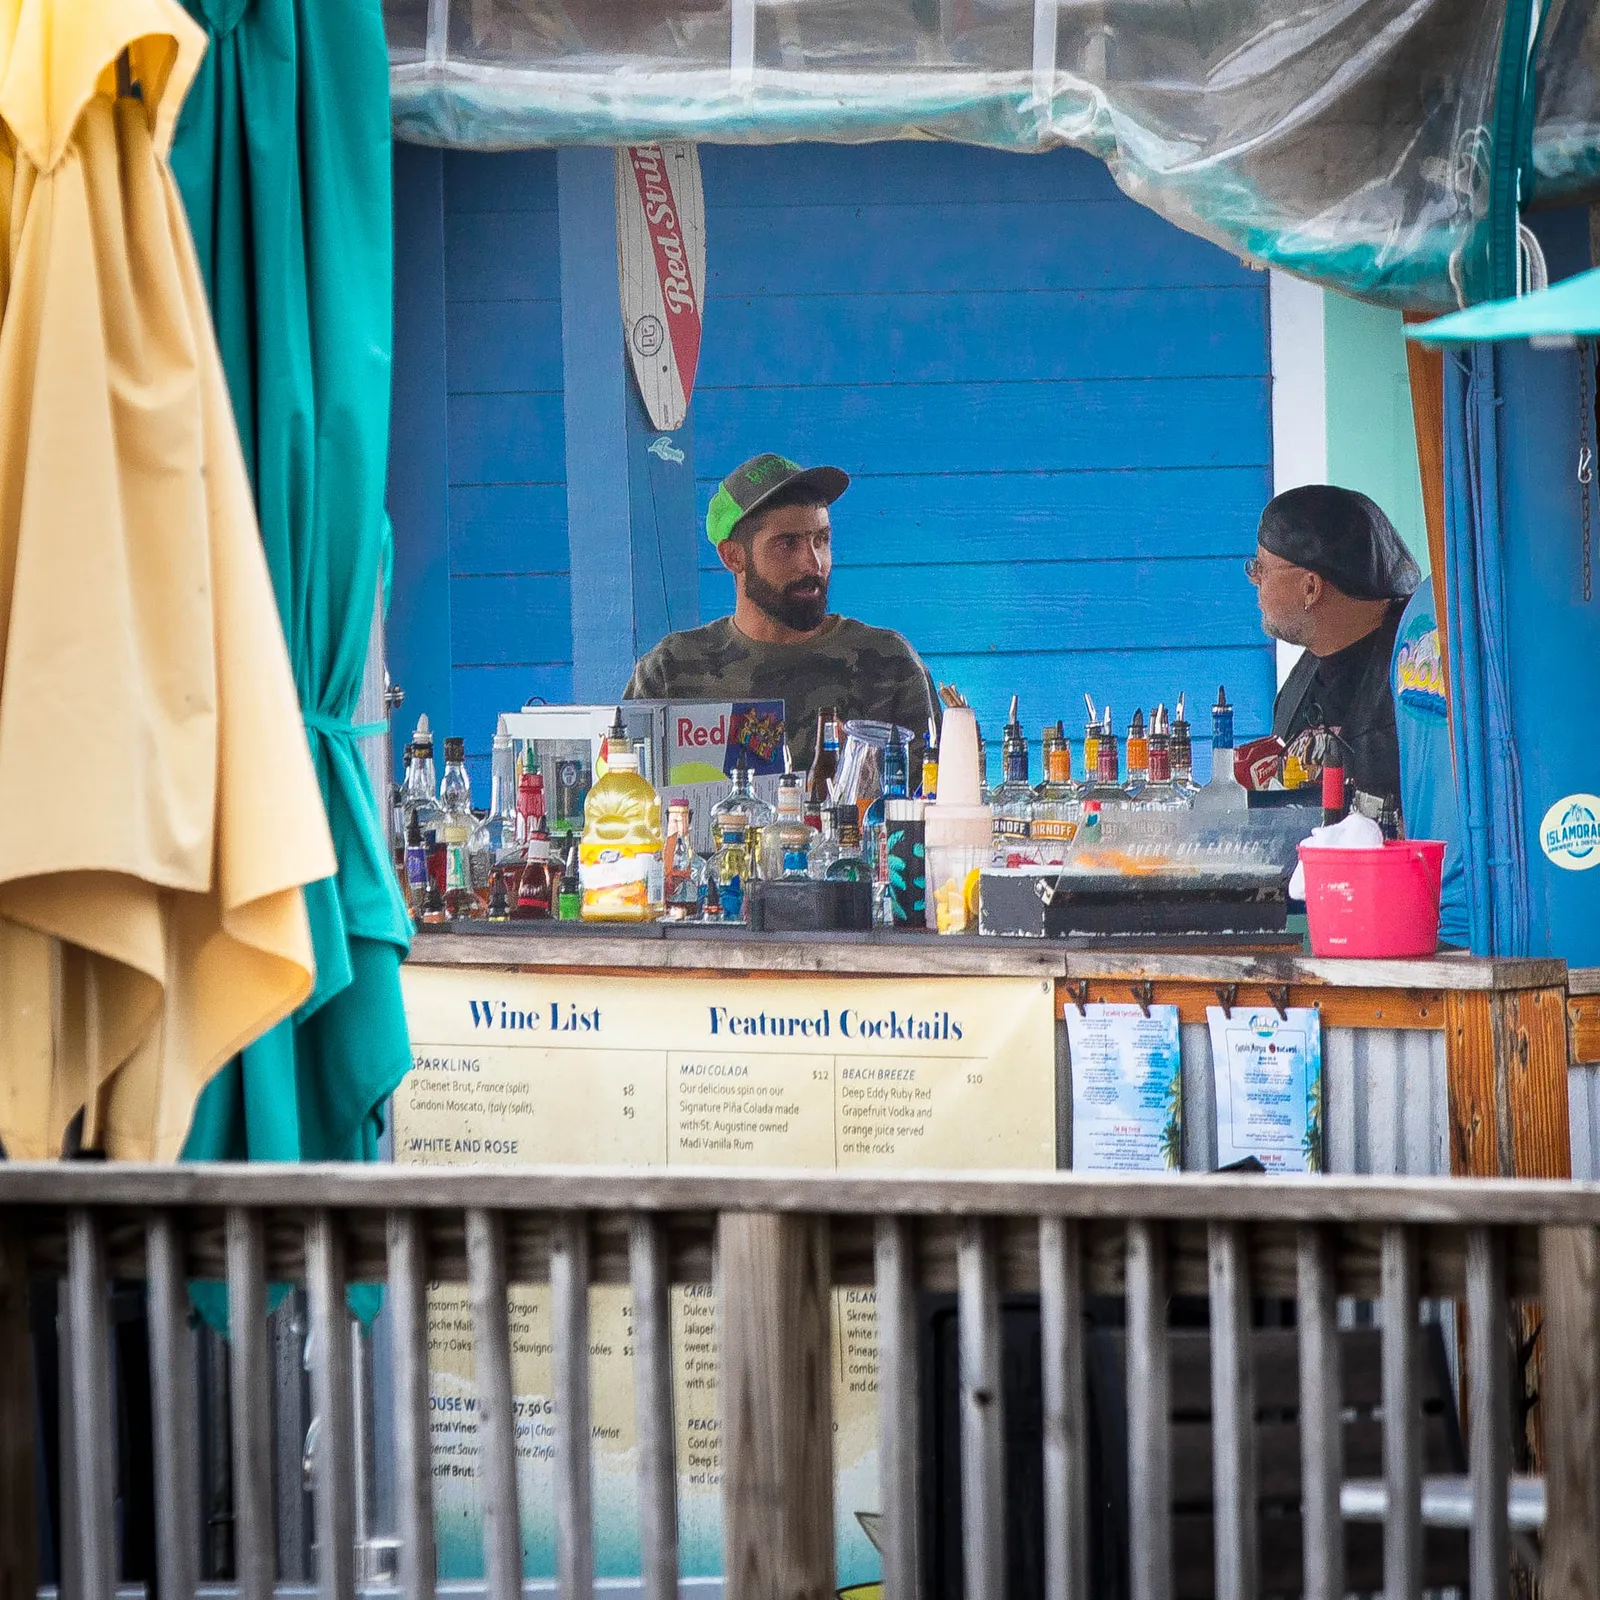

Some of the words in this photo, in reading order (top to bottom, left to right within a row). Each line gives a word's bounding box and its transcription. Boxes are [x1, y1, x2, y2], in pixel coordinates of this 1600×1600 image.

[633, 145, 675, 228] Strip
[656, 231, 694, 315] Red
[677, 714, 727, 747] Red
[991, 820, 1026, 834] IRNOFF
[1127, 843, 1171, 857] EVERY
[1176, 842, 1200, 855] BIT
[1206, 841, 1260, 856] EARNED
[469, 1000, 540, 1030] Wine
[549, 1002, 602, 1031] List
[708, 1006, 830, 1037] Featured
[839, 1008, 964, 1041] Cocktails
[680, 1064, 706, 1076] MADI
[708, 1065, 748, 1077] COLADA
[812, 1070, 829, 1080] $12
[842, 1068, 875, 1080] BEACH
[877, 1069, 916, 1081] BREEZE
[967, 1074, 983, 1085] $10
[410, 1080, 419, 1091] JP
[420, 1079, 450, 1092] Chenet
[453, 1080, 474, 1094] Brut,
[476, 1081, 504, 1093] France
[505, 1082, 530, 1095] (split)
[623, 1083, 635, 1097] $8
[680, 1083, 696, 1094] Our
[698, 1083, 735, 1096] delicious
[737, 1085, 754, 1097] spin
[757, 1087, 767, 1096] on
[770, 1087, 784, 1097] our
[842, 1086, 865, 1100] Deep
[867, 1087, 888, 1100] Eddy
[890, 1088, 912, 1102] Ruby
[915, 1088, 932, 1100] Red
[410, 1098, 444, 1111] Candoni
[446, 1100, 486, 1114] Moscato,
[488, 1101, 507, 1115] Italy
[623, 1105, 635, 1120] $9
[680, 1101, 721, 1115] Signature
[744, 1103, 773, 1115] Colada
[775, 1104, 800, 1115] made
[842, 1105, 886, 1118] Grapefruit
[888, 1106, 915, 1118] Vodka
[917, 1107, 932, 1118] and
[680, 1119, 699, 1130] with
[700, 1120, 711, 1131] St.
[714, 1121, 757, 1134] Augustine
[759, 1122, 789, 1133] owned
[842, 1124, 873, 1138] orange
[874, 1125, 895, 1139] juice
[897, 1125, 924, 1136] served
[411, 1137, 452, 1152] WHITE
[454, 1139, 481, 1153] AND
[484, 1139, 519, 1154] ROSE
[680, 1137, 701, 1149] Madi
[702, 1138, 732, 1150] Vanilla
[734, 1139, 754, 1150] Rum
[843, 1144, 854, 1153] on
[856, 1143, 871, 1154] the
[872, 1143, 895, 1155] rocks
[684, 1286, 713, 1298] CARIB
[846, 1291, 876, 1304] ISLAN
[428, 1301, 459, 1311] nstorm
[507, 1302, 538, 1316] Oregon
[622, 1306, 634, 1317] $1
[684, 1304, 706, 1317] Dulce
[847, 1309, 877, 1322] Skrew
[427, 1321, 452, 1333] piche
[508, 1322, 529, 1334] ntina
[684, 1324, 714, 1336] Jalape
[847, 1329, 872, 1340] white
[427, 1340, 443, 1351] ohr
[449, 1338, 472, 1352] Oaks
[512, 1341, 554, 1357] Sauvigno
[623, 1346, 635, 1357] $1
[684, 1342, 710, 1354] sweet
[848, 1346, 878, 1359] Pineap
[685, 1360, 693, 1371] of
[695, 1360, 715, 1374] pine
[849, 1364, 877, 1375] combi
[685, 1378, 704, 1390] with
[850, 1381, 866, 1392] and
[430, 1397, 462, 1411] OUSE
[430, 1424, 452, 1434] astal
[453, 1422, 477, 1434] Vines
[515, 1424, 531, 1440] igio
[592, 1426, 620, 1440] Merlot
[688, 1437, 707, 1449] Cool
[431, 1443, 456, 1455] ernet
[457, 1443, 479, 1456] Sauv
[515, 1445, 531, 1458] hite
[531, 1446, 555, 1462] Zinfa
[689, 1455, 712, 1469] Deep
[431, 1464, 450, 1477] cliff
[690, 1471, 705, 1485] and
